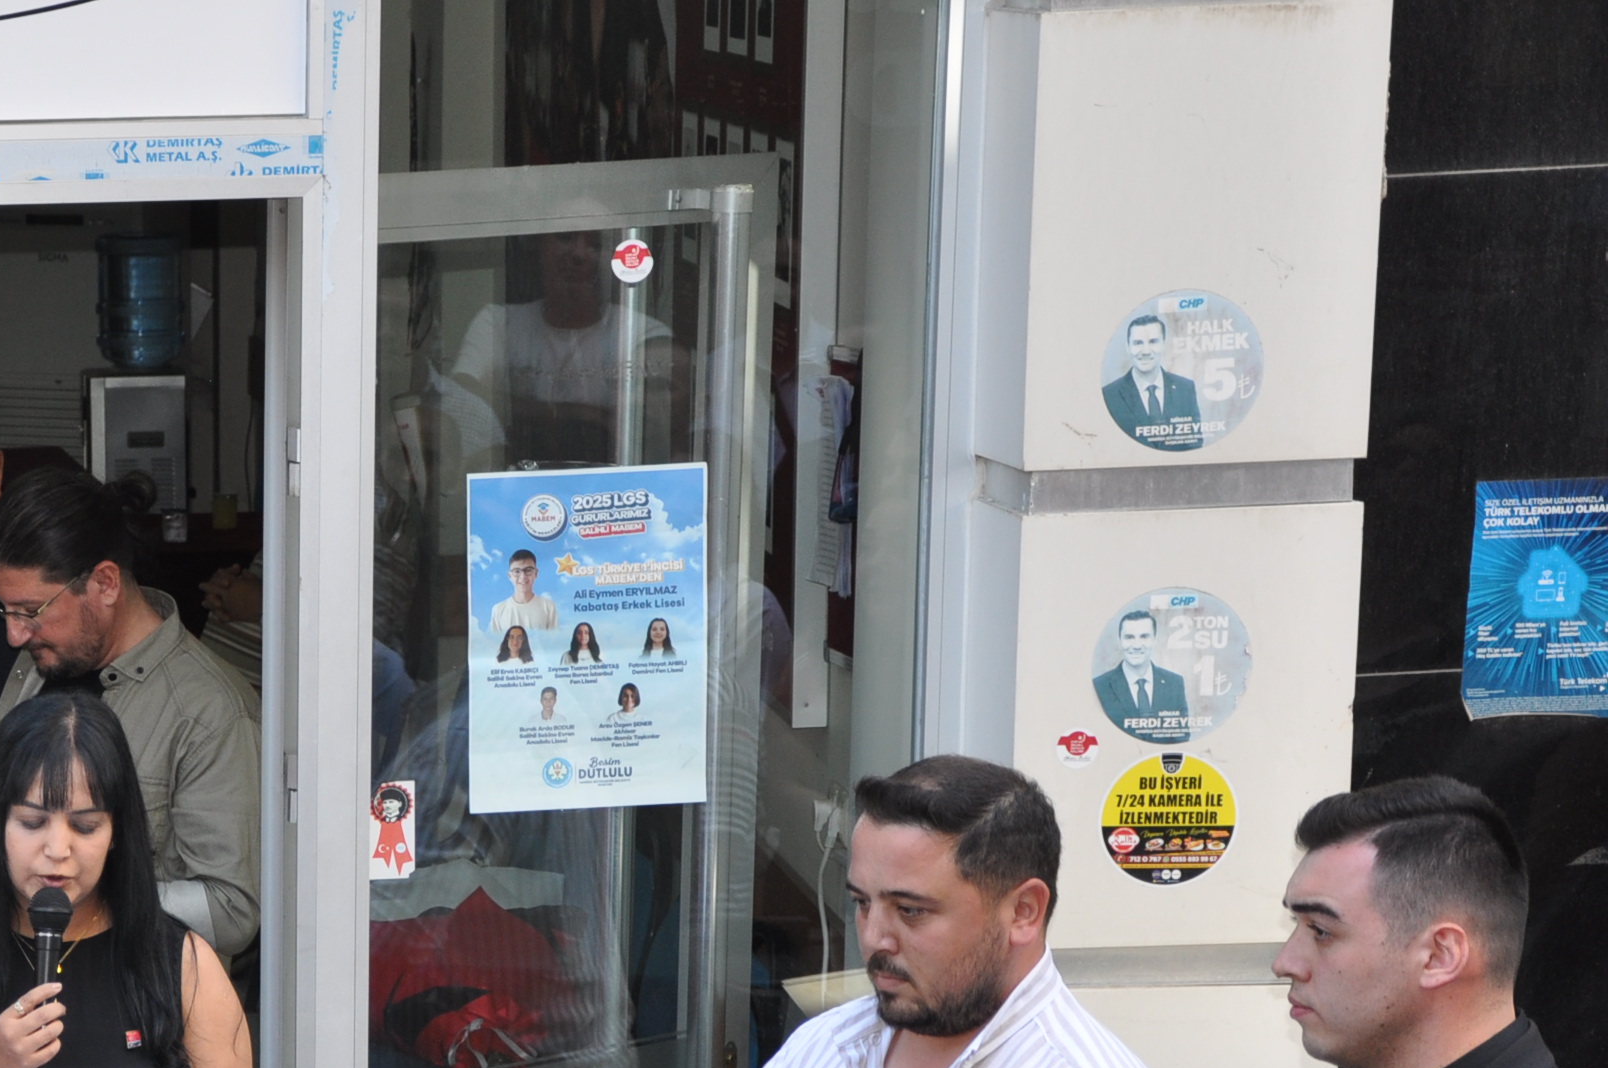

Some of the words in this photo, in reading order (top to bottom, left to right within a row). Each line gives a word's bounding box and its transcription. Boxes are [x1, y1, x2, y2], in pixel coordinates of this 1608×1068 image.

[146, 151, 192, 163] METAL
[196, 150, 222, 163] A.Ş.
[1179, 298, 1205, 309] CHP
[1187, 318, 1234, 335] HALK
[1172, 332, 1250, 354] EKMEK
[1202, 357, 1237, 401] 5
[1135, 425, 1173, 437] FERDİ
[1175, 421, 1226, 434] ZEYREK
[573, 494, 611, 511] 2025
[614, 491, 647, 506] LGS
[571, 509, 649, 525] GURURLARIMIZ
[1484, 507, 1511, 516] TÜRK
[1513, 505, 1574, 516] TELEKOMLU
[1483, 518, 1504, 529] ÇOK
[1506, 516, 1540, 526] KOLAY
[573, 566, 594, 576] LGS
[597, 562, 640, 575] TÜRKİYE
[574, 590, 587, 599] Ali
[589, 588, 623, 600] Eymen
[625, 586, 677, 597] ERYILMAZ
[574, 602, 619, 612] Kabataş
[621, 600, 652, 610] Erkek
[655, 598, 685, 608] Lisesi
[1170, 596, 1195, 606] CHP
[1167, 616, 1192, 649] 2
[1194, 616, 1229, 628] TON
[1194, 631, 1228, 649] SU
[1193, 655, 1214, 697] 1
[1577, 677, 1607, 685] Telekom
[1124, 717, 1161, 728] FERDİ
[1163, 716, 1213, 728] ZEYREK
[589, 756, 621, 768] Besim
[578, 766, 633, 779] DUTLULU
[1139, 777, 1157, 790] BU
[1161, 774, 1202, 792] İŞYERİ
[1116, 794, 1145, 808] 7/24
[1149, 794, 1202, 807] KAMERA
[1206, 791, 1223, 807] İLE
[1119, 809, 1217, 824] İZLENMEKTEDİR
